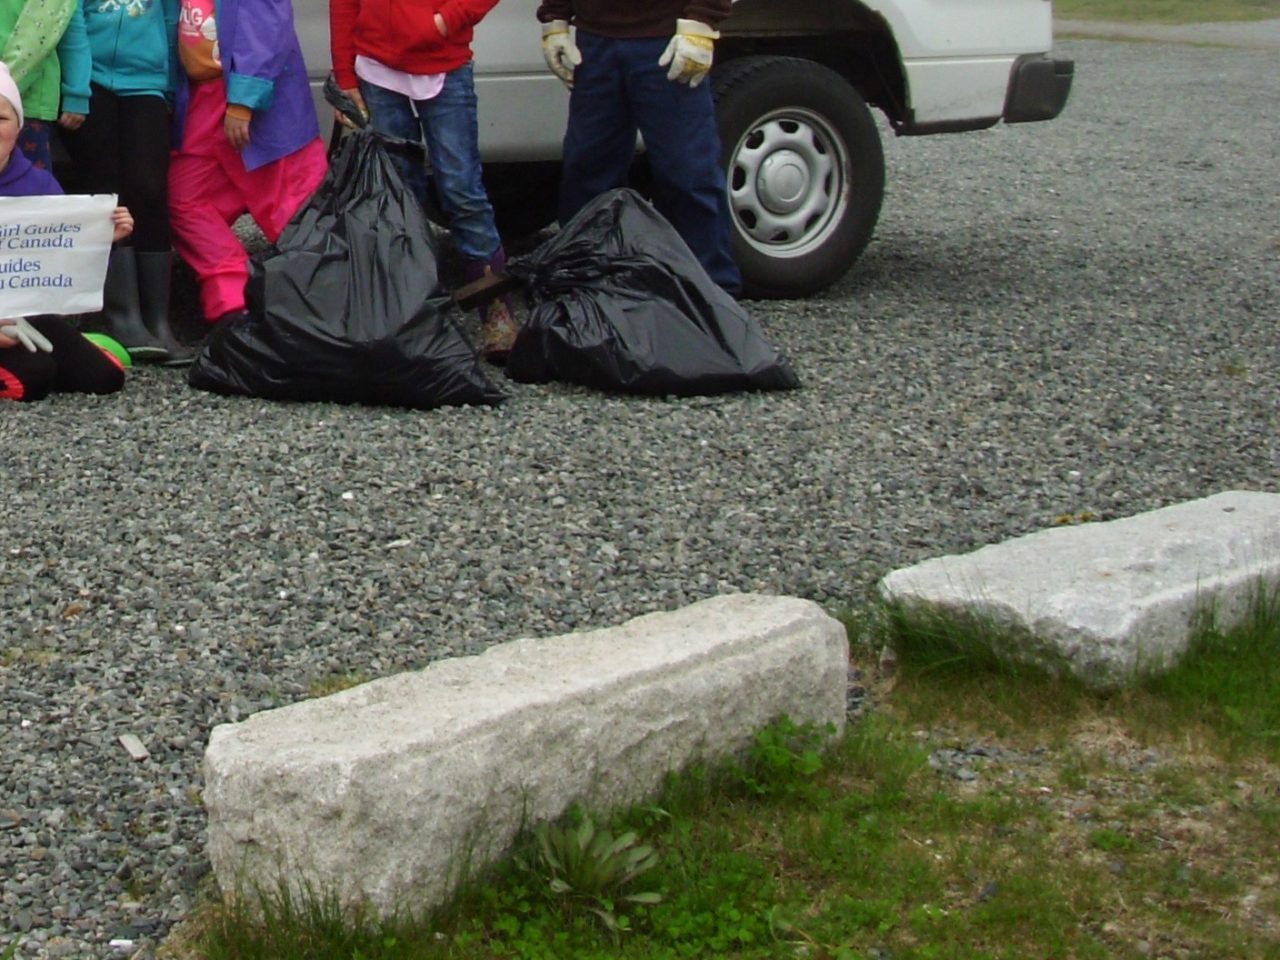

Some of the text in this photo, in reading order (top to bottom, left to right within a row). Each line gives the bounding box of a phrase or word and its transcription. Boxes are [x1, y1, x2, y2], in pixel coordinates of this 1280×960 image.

[24, 223, 81, 235] Guides
[7, 235, 73, 249] Canada
[8, 274, 73, 288] Canada
